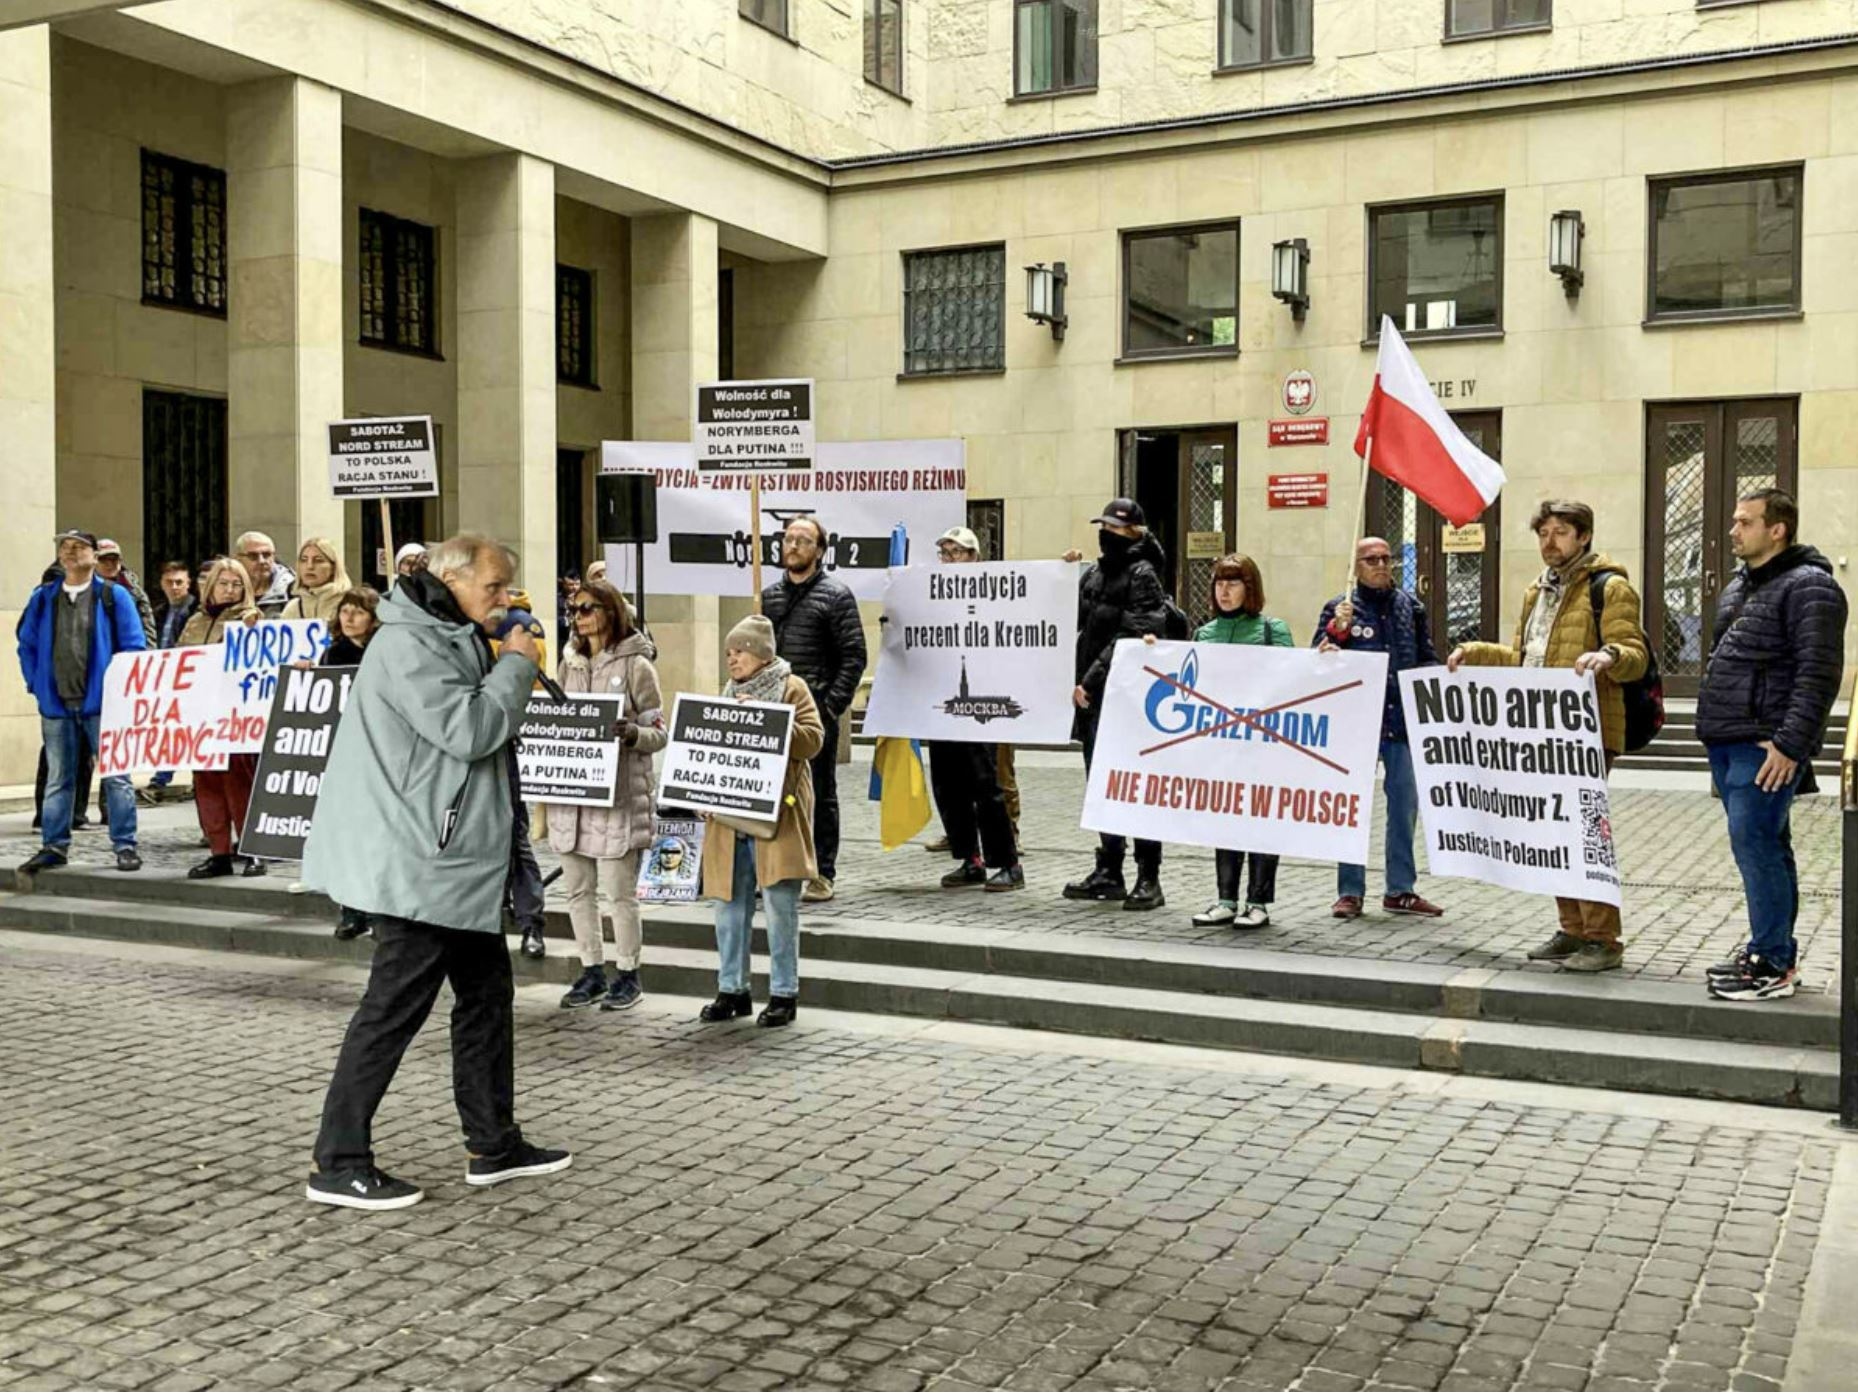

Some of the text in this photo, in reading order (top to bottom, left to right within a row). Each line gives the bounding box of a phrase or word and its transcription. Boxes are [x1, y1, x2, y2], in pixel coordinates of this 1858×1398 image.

[715, 389, 791, 401] Wolność dla
[1461, 379, 1476, 396] IV
[708, 425, 800, 437] NORYMBERGA
[339, 439, 423, 452] NORD STREAM
[708, 444, 733, 455] DLA
[737, 443, 786, 455] PUTINA
[346, 455, 411, 466] TO POLSKA
[338, 472, 375, 482] RACJA
[379, 470, 418, 481] STANU
[815, 470, 908, 491] ROSYJSKIEGO
[913, 467, 966, 491] REŻIMU
[849, 542, 859, 565] 2
[930, 571, 1027, 600] Ekstradycja
[968, 605, 975, 614] =
[905, 620, 1058, 650] prezent dla Kremla
[224, 624, 293, 672] NORD
[239, 670, 278, 704] fin
[283, 670, 334, 714] No
[133, 697, 181, 726] DLA
[580, 703, 600, 717] dla
[702, 706, 764, 726] SABOTAŻ
[952, 702, 1009, 716] МОСКВА
[1413, 678, 1598, 733] No to arres
[217, 708, 265, 743] zbro
[1196, 705, 1329, 748] GAZPROM
[274, 724, 332, 757] and
[684, 726, 779, 750] NORD STREAM
[1422, 731, 1474, 766] and
[516, 744, 603, 760] ORYMBERGA
[688, 749, 760, 770] TO POLSKA
[265, 770, 291, 794] of
[535, 765, 587, 780] PUTINA
[673, 769, 715, 785] RACJA
[720, 775, 763, 792] STANU
[1105, 769, 1360, 828] NIE DECYDUJE W POLSCE
[1430, 781, 1569, 822] of Volodymyr Z.
[255, 812, 311, 838] Justic
[1438, 829, 1489, 856] Justice
[1490, 835, 1502, 861] in
